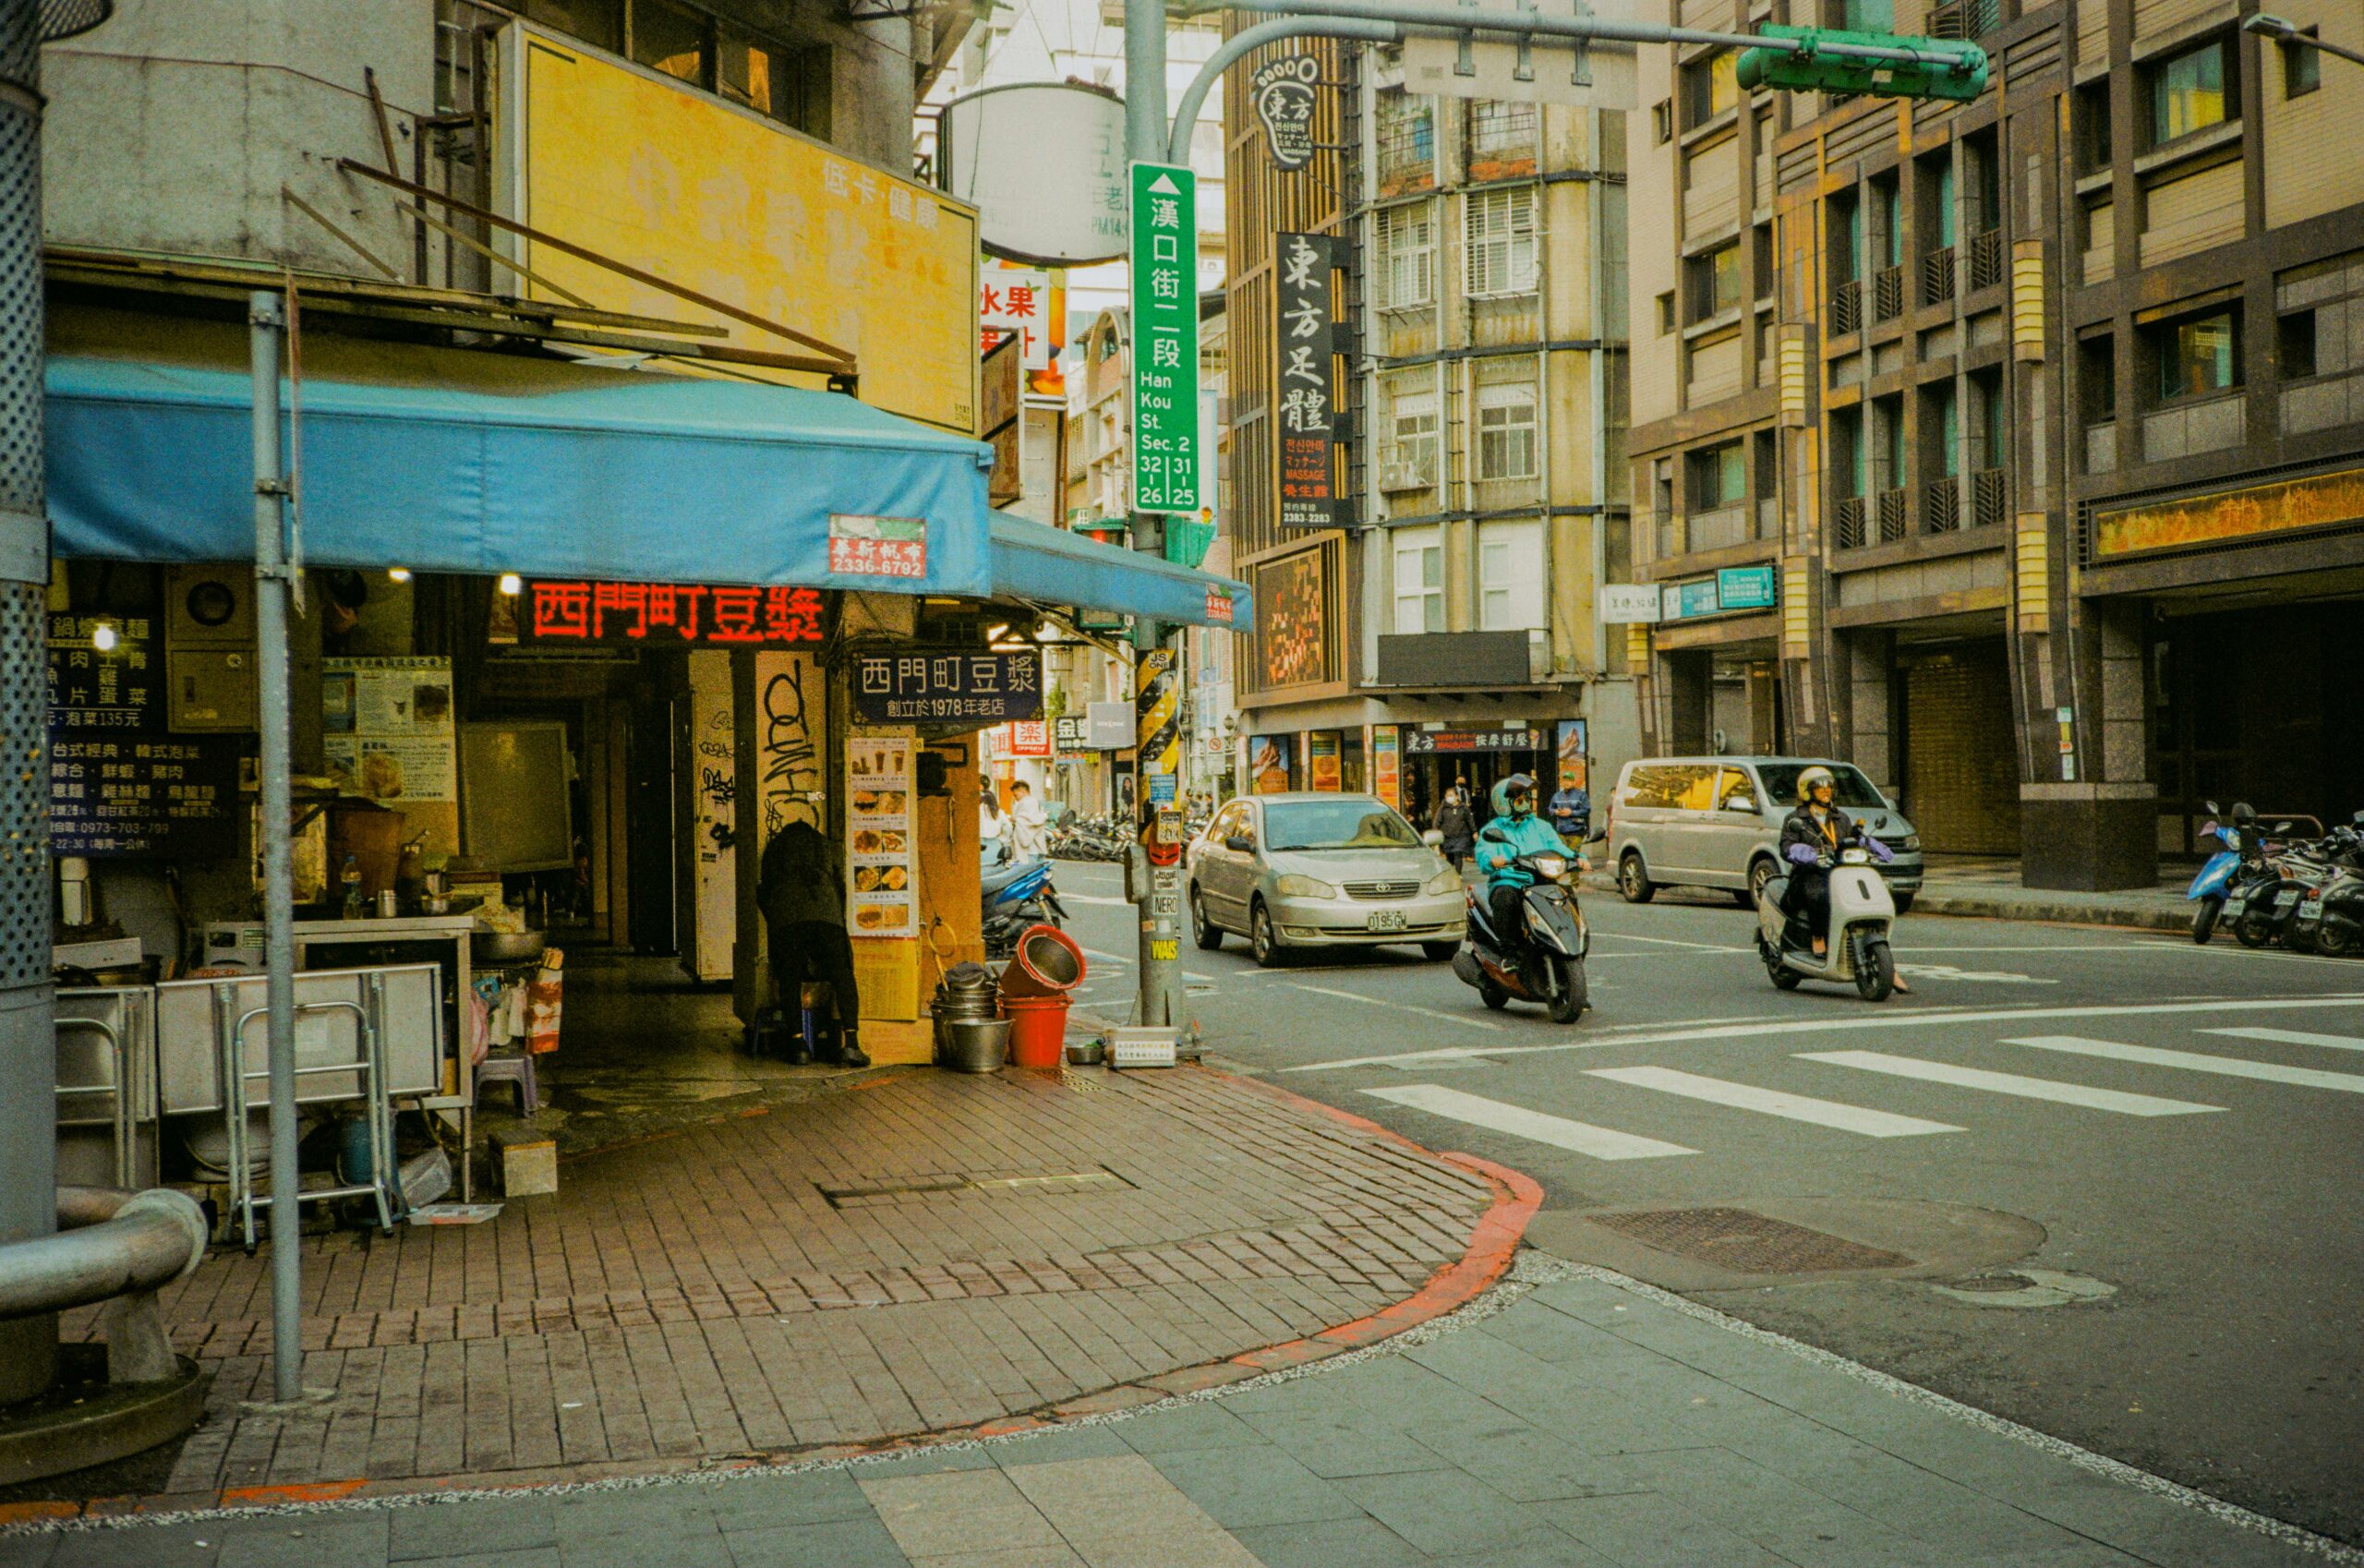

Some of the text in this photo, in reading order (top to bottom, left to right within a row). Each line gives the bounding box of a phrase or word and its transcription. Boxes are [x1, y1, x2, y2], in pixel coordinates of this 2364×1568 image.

[1268, 89, 1310, 120] 東方
[1151, 198, 1181, 368] 漢口街二段
[1280, 235, 1331, 433] 東方足體
[1140, 371, 1172, 388] Han
[1140, 392, 1171, 409] Kou
[1141, 414, 1162, 429] St.
[1141, 434, 1189, 452] Sec. 2
[1140, 455, 1190, 474] 32 31
[1285, 469, 1326, 480] MASSAGE
[1140, 487, 1194, 505] 26 25
[1284, 513, 1330, 523] 2383-2283
[833, 558, 922, 576] 2336-6792
[532, 582, 824, 642] 西門町豆漿
[1152, 653, 1166, 661] JS
[862, 656, 1036, 694] 西門町豆漿
[886, 698, 1005, 718] 創立於1978年老店
[1406, 733, 1434, 751] 東方
[1154, 897, 1177, 913] NERO
